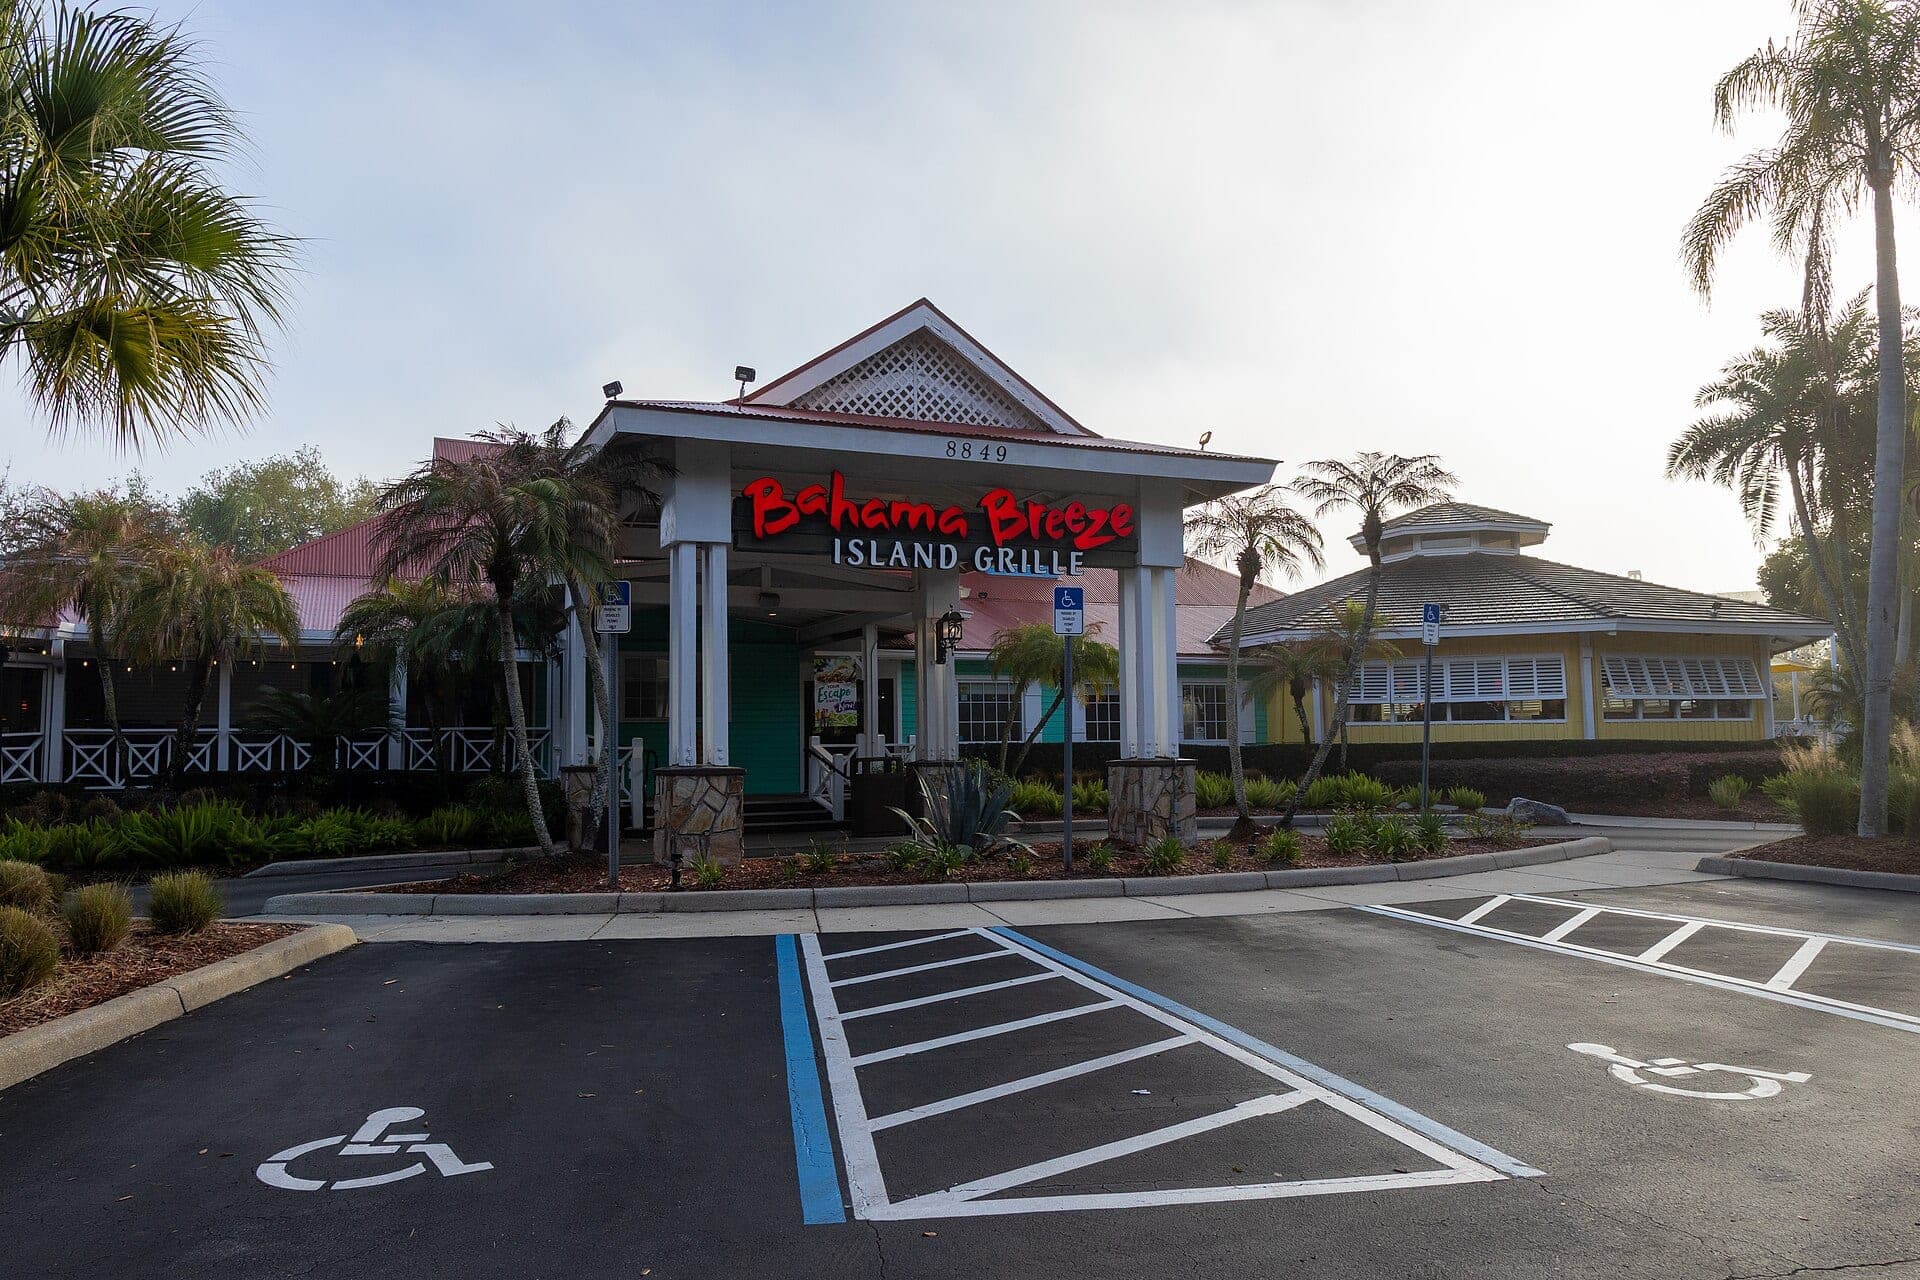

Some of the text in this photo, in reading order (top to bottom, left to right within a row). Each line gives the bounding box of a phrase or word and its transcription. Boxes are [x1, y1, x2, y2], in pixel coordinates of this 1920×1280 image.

[946, 440, 1007, 462] 8849
[742, 469, 1136, 550] Bahama Breeze
[834, 538, 1084, 576] ISLAND GRILLE
[818, 686, 851, 703] Escape
